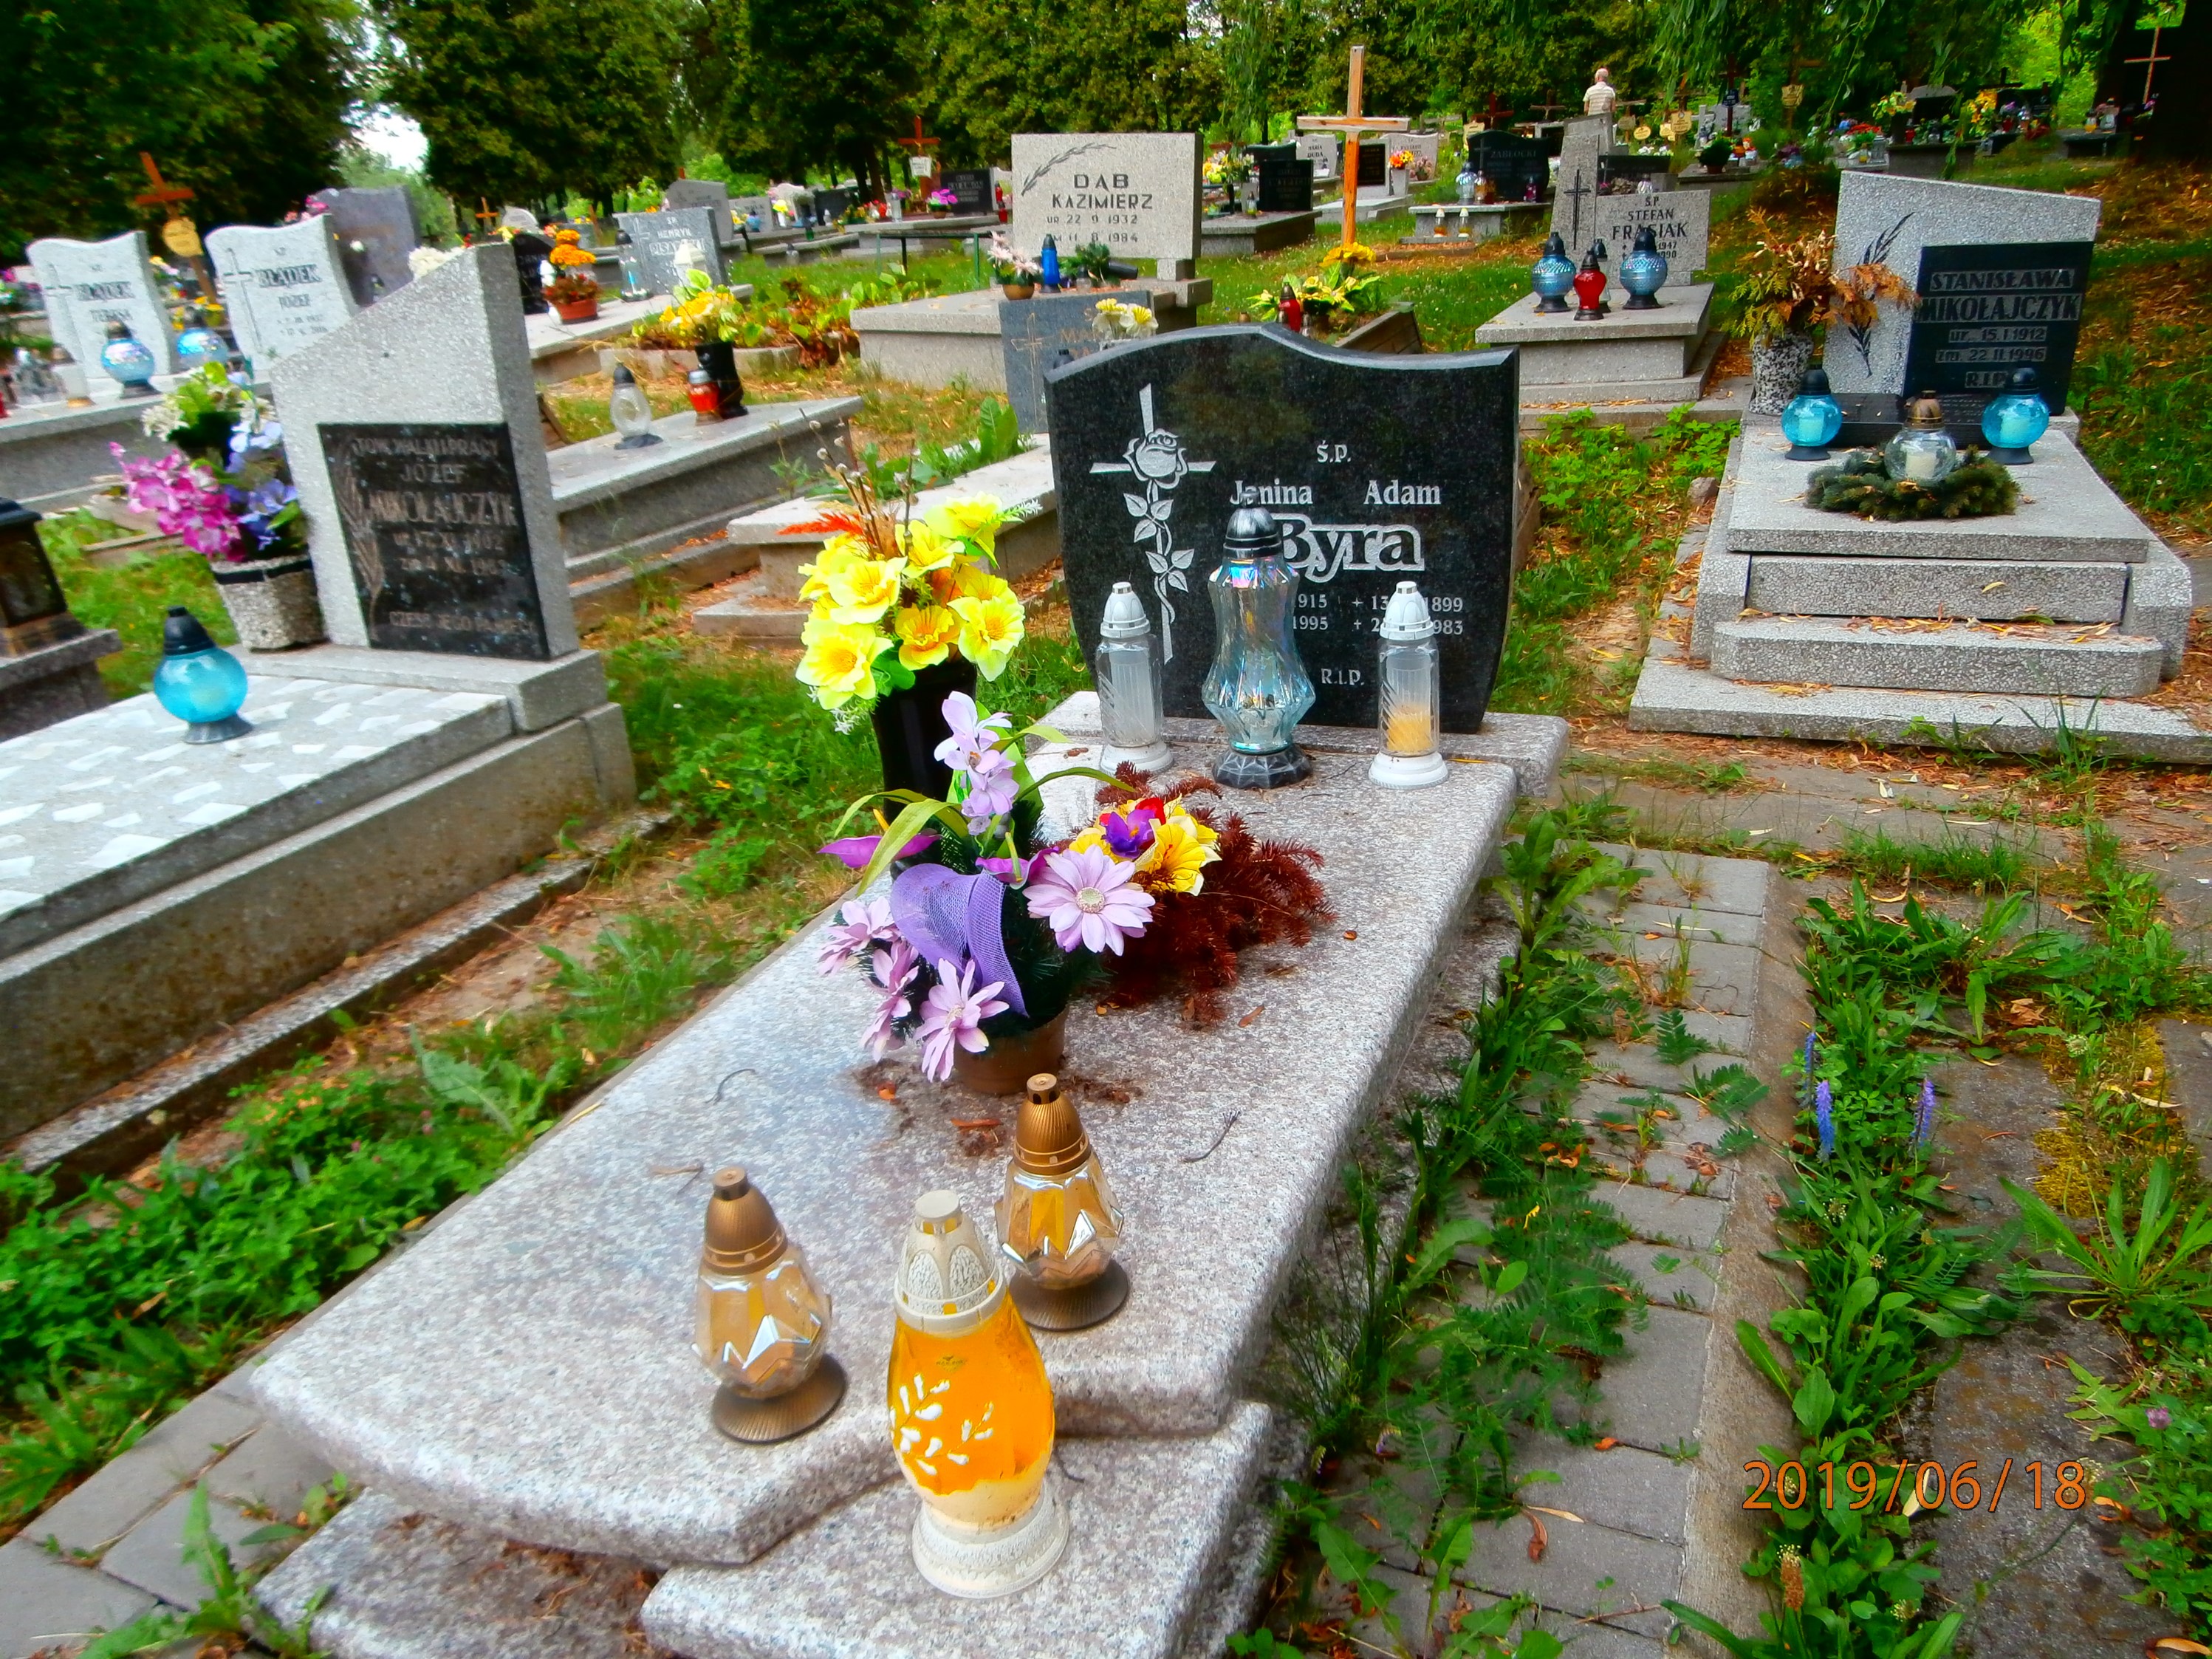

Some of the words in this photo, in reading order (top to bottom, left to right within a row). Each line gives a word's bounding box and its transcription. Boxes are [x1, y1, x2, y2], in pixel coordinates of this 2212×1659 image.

[1052, 194, 1153, 210] KAZIMIERZ
[1066, 214, 1081, 224] 22
[1108, 214, 1137, 225] 1932
[1628, 208, 1674, 221] STEFAN
[657, 228, 692, 239] HENRYK
[1108, 233, 1138, 242] 1984
[1612, 222, 1689, 240] FRASIAK
[1931, 269, 2072, 290] STANISŁAWA
[1919, 295, 2081, 321] MIKOŁAJCZYK
[1316, 439, 1352, 463] Ś.P.
[1363, 479, 1441, 504] Adam
[1270, 513, 1425, 583] Byra
[1295, 593, 1327, 609] 915
[1433, 619, 1463, 635] 983
[1321, 668, 1365, 686] R.I.P.
